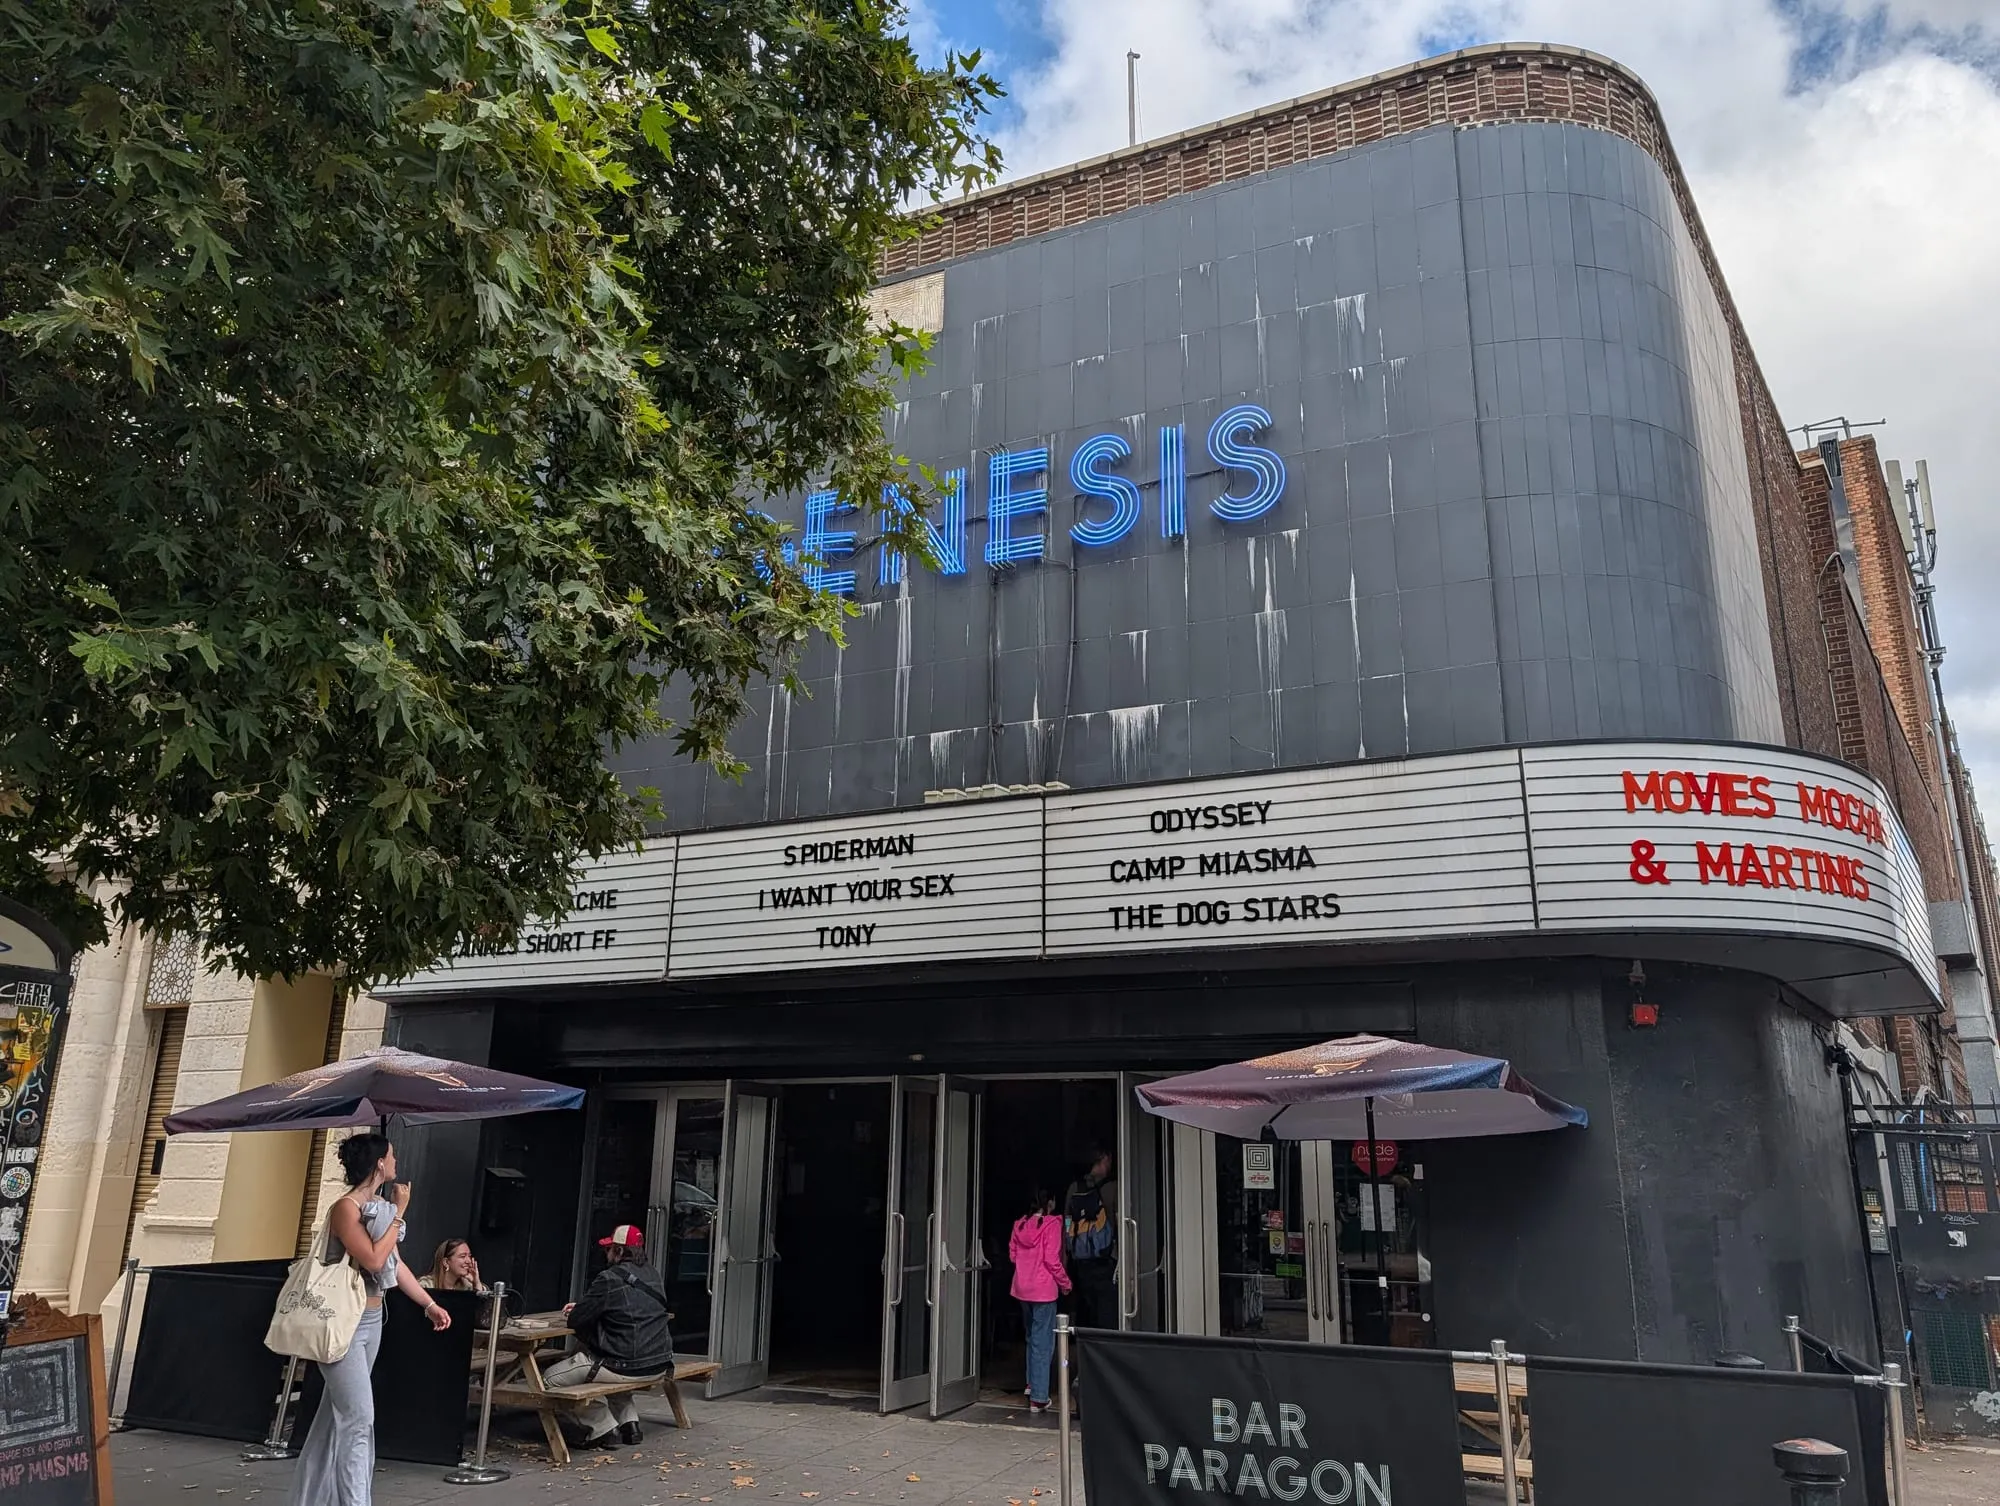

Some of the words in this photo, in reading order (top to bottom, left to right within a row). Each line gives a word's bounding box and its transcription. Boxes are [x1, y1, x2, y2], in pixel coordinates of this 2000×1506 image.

[713, 404, 1287, 609] ENESIS
[1622, 770, 1776, 819] MOVIES
[1150, 800, 1272, 833] ODYSSEY
[783, 833, 914, 866] SPIDERMAN
[1110, 855, 1185, 883] CAMP
[1199, 844, 1316, 877] MIASMA
[1630, 839, 1671, 885] &
[1696, 840, 1870, 902] MARTINIS
[576, 889, 619, 911] CME
[759, 889, 764, 910] I
[771, 883, 837, 909] WANT
[846, 878, 901, 903] YOUR
[910, 873, 954, 898] SEX
[1108, 904, 1164, 931] THE
[1177, 900, 1230, 927] DOG
[1243, 893, 1341, 922] STARS
[525, 932, 585, 955] SHORT
[592, 929, 617, 950] FF
[816, 923, 876, 949] TONY
[1212, 1398, 1309, 1449] BAR
[38, 1442, 53, 1453] AND
[28, 1451, 89, 1484] MIASMA
[1143, 1443, 1392, 1506] PARAGON
